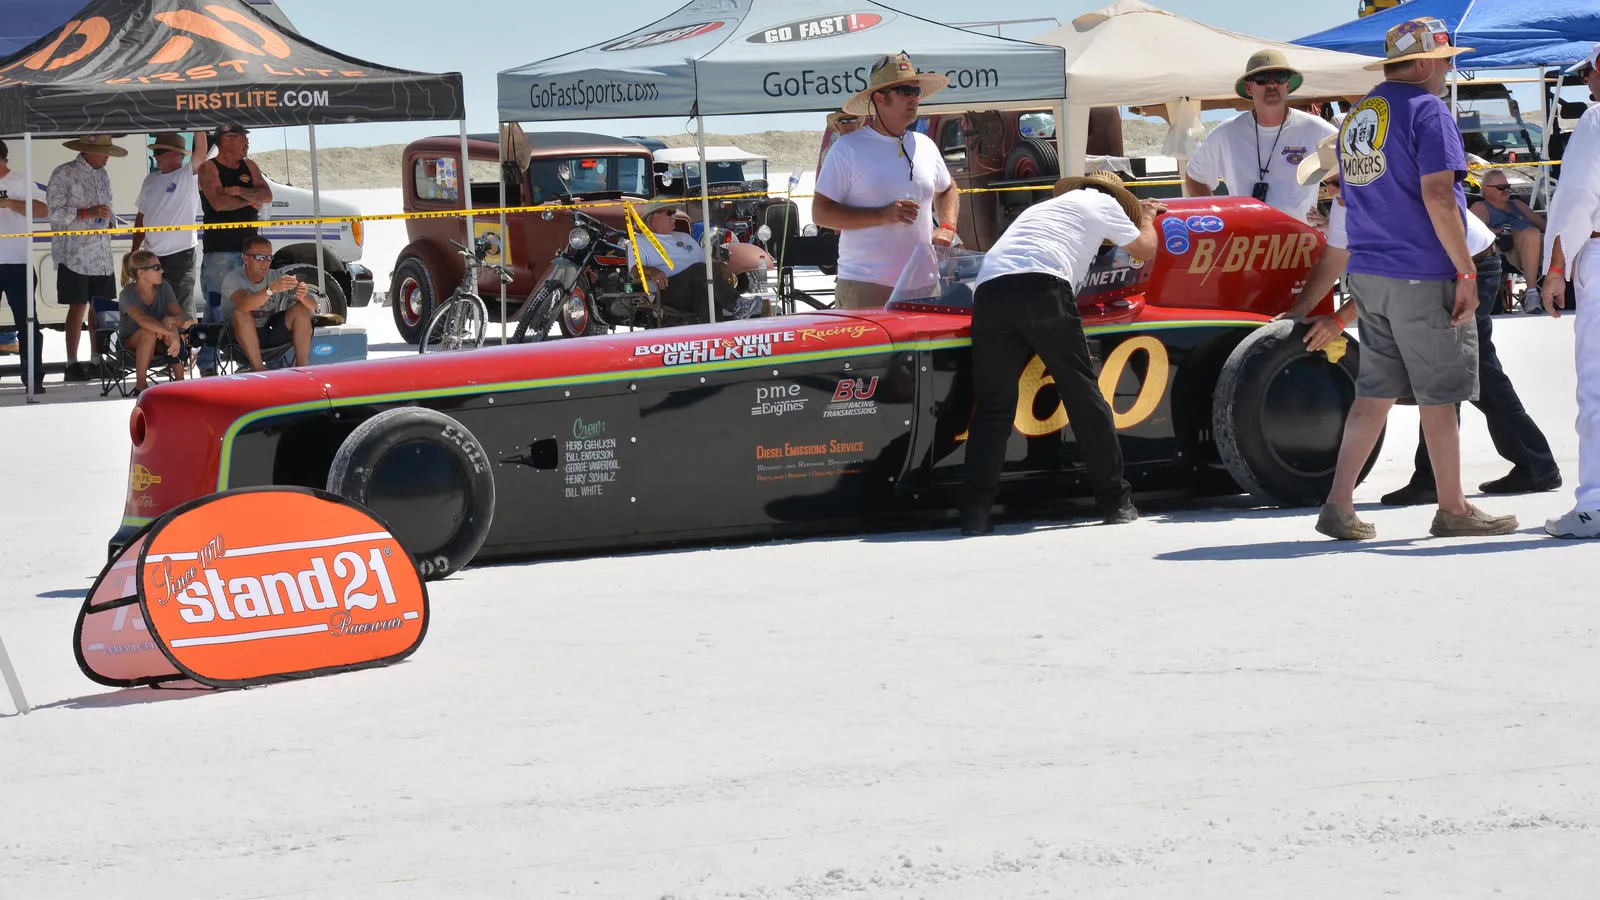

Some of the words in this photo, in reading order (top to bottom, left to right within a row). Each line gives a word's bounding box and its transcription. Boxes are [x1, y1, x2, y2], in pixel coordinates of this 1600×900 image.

[764, 26, 792, 43] GO
[800, 15, 844, 39] FAST
[263, 64, 369, 77] LITE
[175, 89, 329, 111] FIRSTLITE.COM
[530, 79, 659, 110] GoFastSports.com
[1341, 155, 1382, 177] MOKERS
[634, 338, 722, 356] BONNETT
[733, 330, 795, 346] WHITE
[796, 325, 877, 343] Racing
[662, 343, 773, 366] GEHLKEN
[756, 384, 801, 404] pme
[831, 375, 880, 402] B&J
[761, 401, 805, 416] Engines
[822, 407, 878, 418] TRANSMISSIONS
[847, 400, 875, 409] RACING
[565, 440, 583, 451] HERB
[584, 438, 617, 450] GEHLKEN
[756, 445, 784, 460] DIESEL
[784, 442, 827, 457] EMISSIONS
[829, 439, 864, 453] SERVICE
[565, 452, 580, 462] BILL
[565, 462, 588, 473] GEORGE
[565, 473, 587, 484] HENRY
[588, 471, 616, 482] SCHULZ
[565, 487, 580, 498] BILL
[581, 485, 603, 496] WHITE
[151, 556, 198, 605] Since
[198, 534, 227, 569] 1970
[330, 610, 404, 638] Racewear
